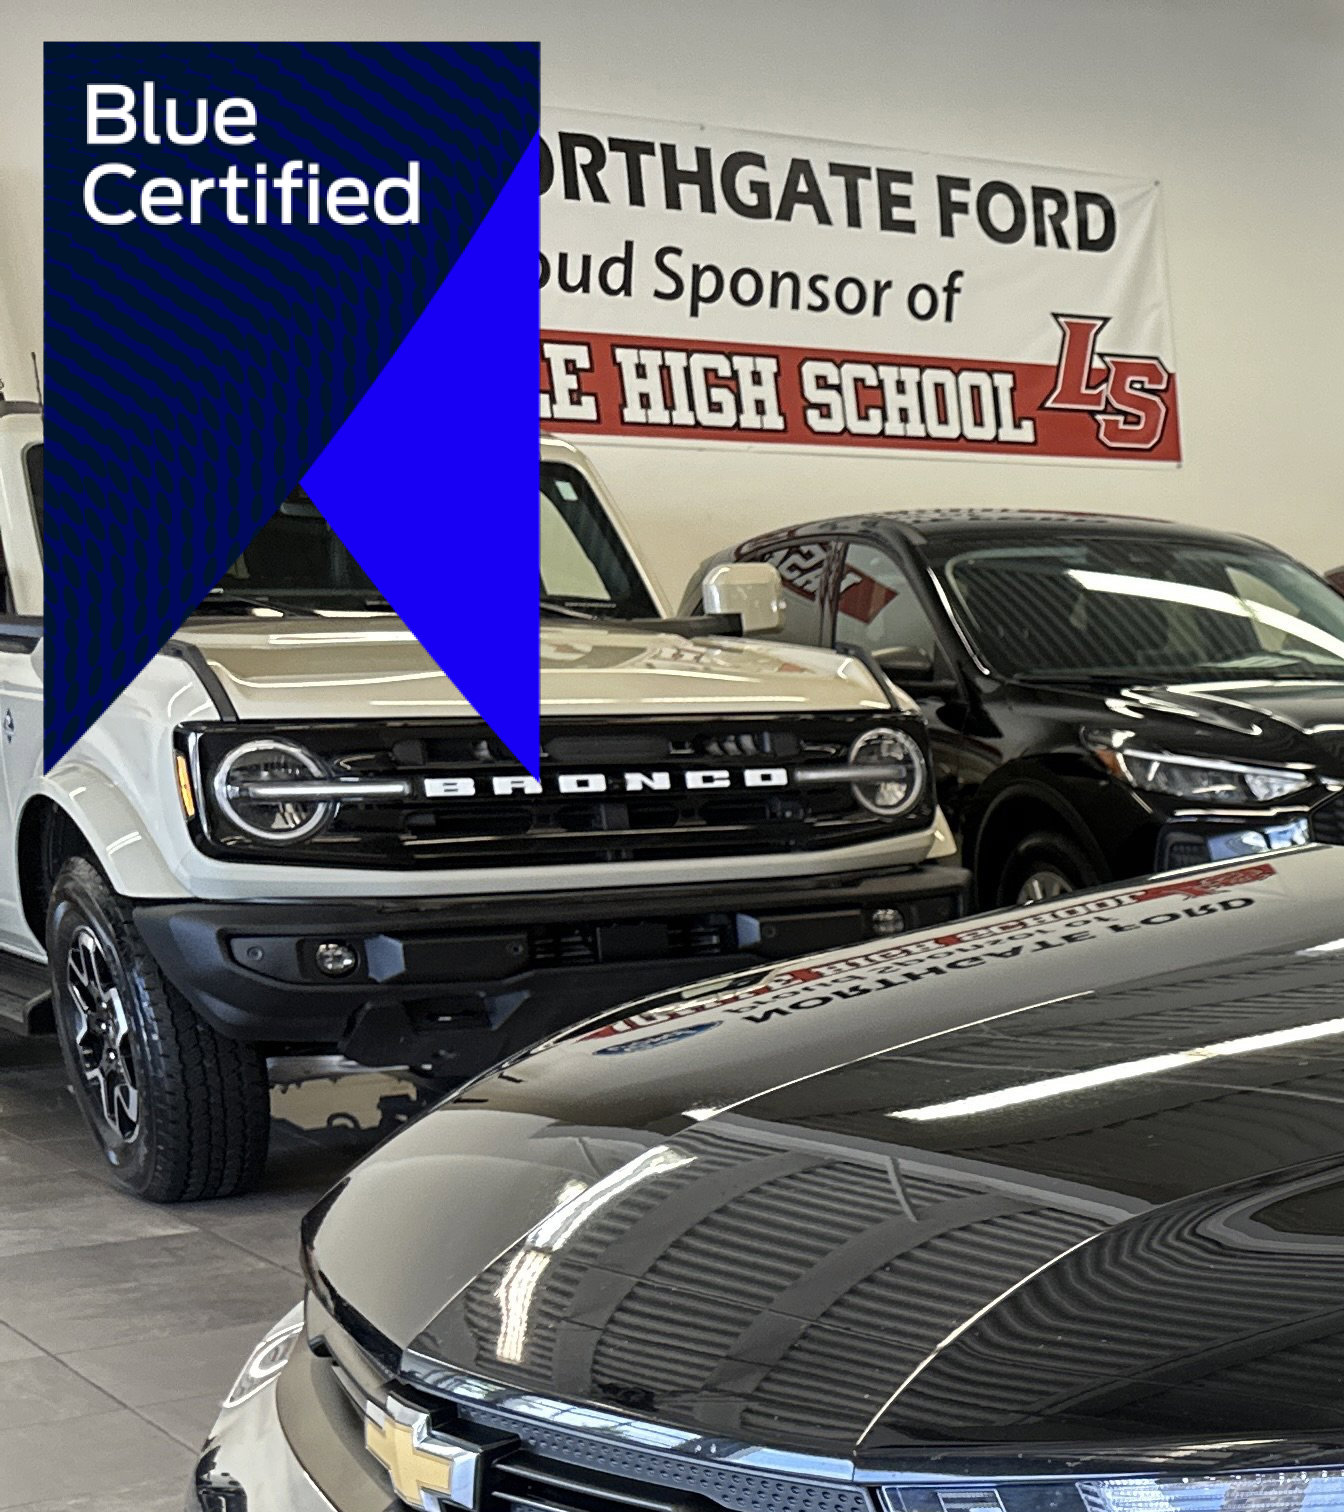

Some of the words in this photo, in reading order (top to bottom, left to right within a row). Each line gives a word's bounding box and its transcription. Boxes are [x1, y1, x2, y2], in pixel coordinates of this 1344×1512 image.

[539, 131, 917, 235] RTHGATE
[936, 174, 1117, 254] FORD
[653, 245, 893, 318] Sponsor
[906, 270, 965, 323] of
[611, 344, 787, 433] HIGH
[799, 357, 1037, 444] SCHOOL
[423, 767, 789, 797] BRONCO
